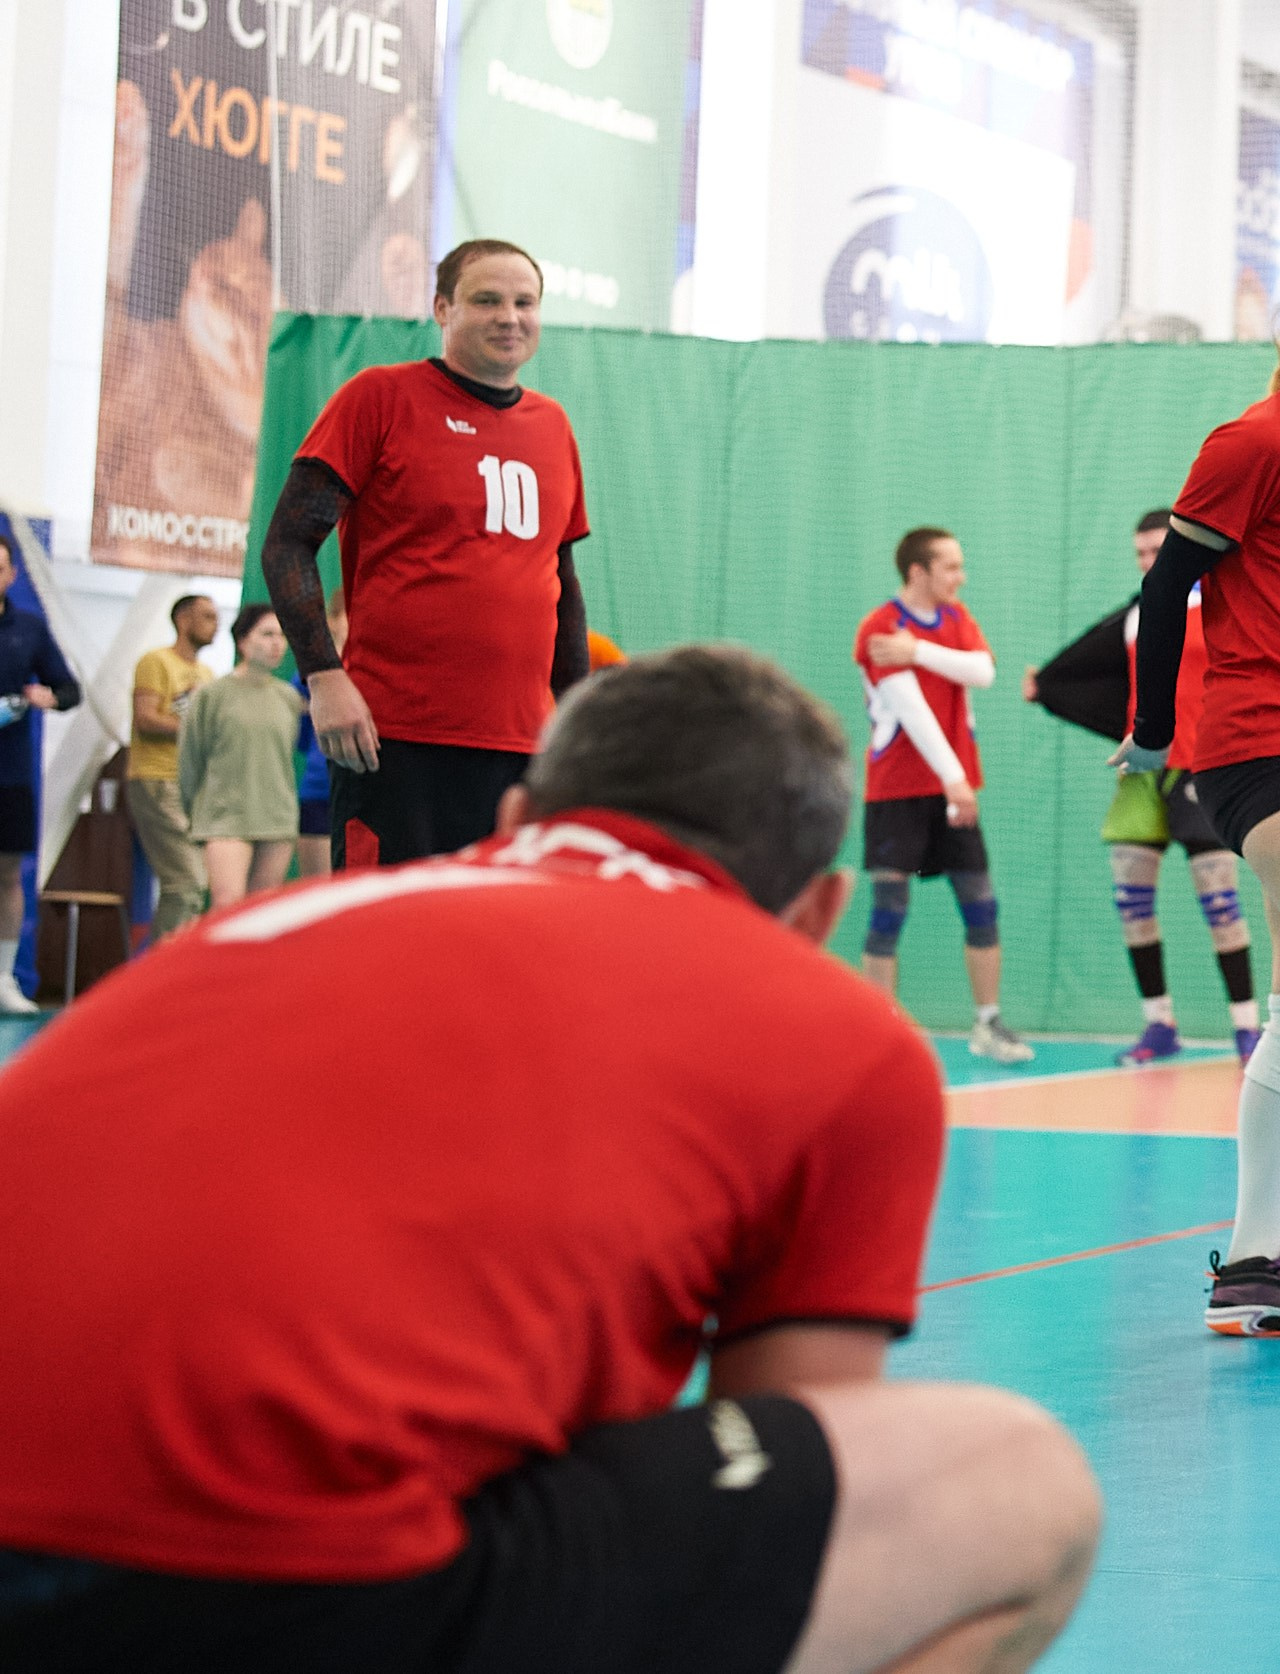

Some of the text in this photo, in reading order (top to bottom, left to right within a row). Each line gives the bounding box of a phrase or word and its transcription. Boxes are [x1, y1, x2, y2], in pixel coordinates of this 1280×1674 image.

[226, 0, 402, 94] СТИЛЕ
[168, 67, 347, 185] ХЮГГЕ
[477, 454, 540, 540] 10
